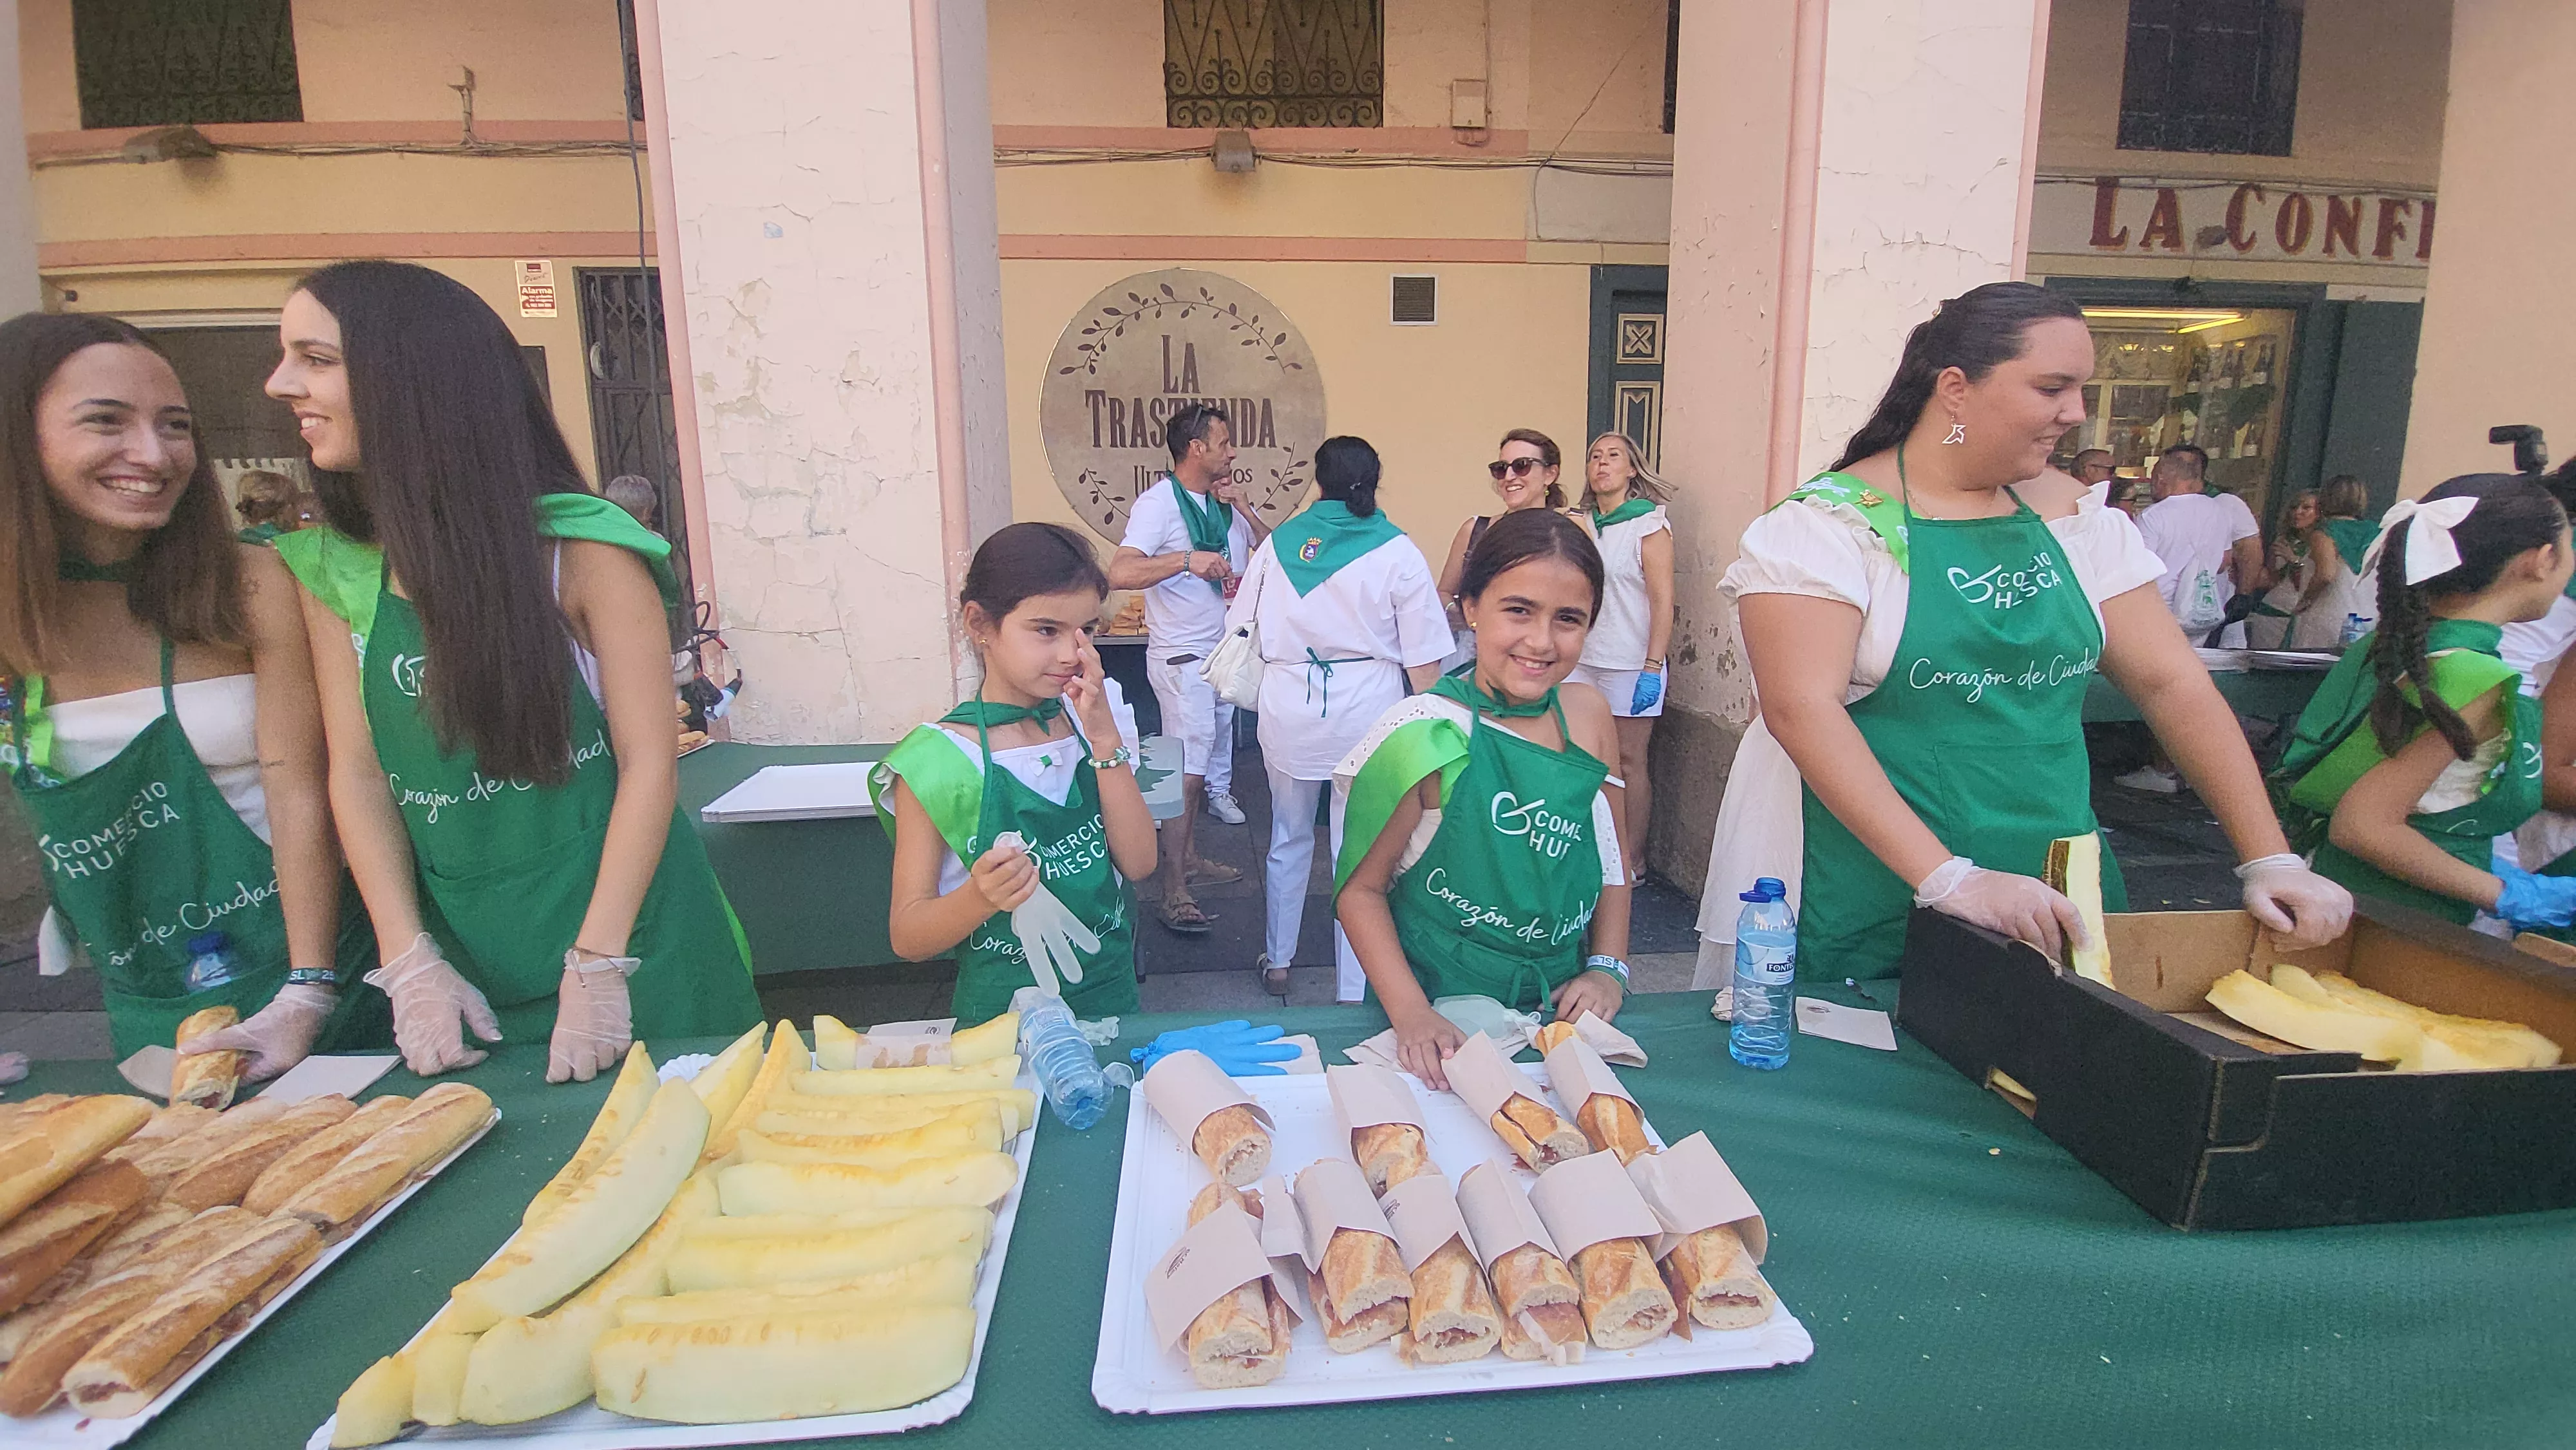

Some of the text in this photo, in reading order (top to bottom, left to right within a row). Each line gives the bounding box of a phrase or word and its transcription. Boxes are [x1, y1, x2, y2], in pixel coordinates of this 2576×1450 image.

[2088, 176, 2185, 252] LA
[1161, 334, 1201, 393] LA
[1084, 390, 1277, 448] TRASNDA
[1909, 658, 2012, 702] Corazón
[2017, 660, 2045, 690] de
[466, 772, 504, 801] de
[1045, 833, 1108, 881] HUESC
[1426, 867, 1515, 927] Corazón
[1516, 917, 1549, 944] de
[142, 916, 177, 946] de
[970, 921, 1028, 965] Coraz
